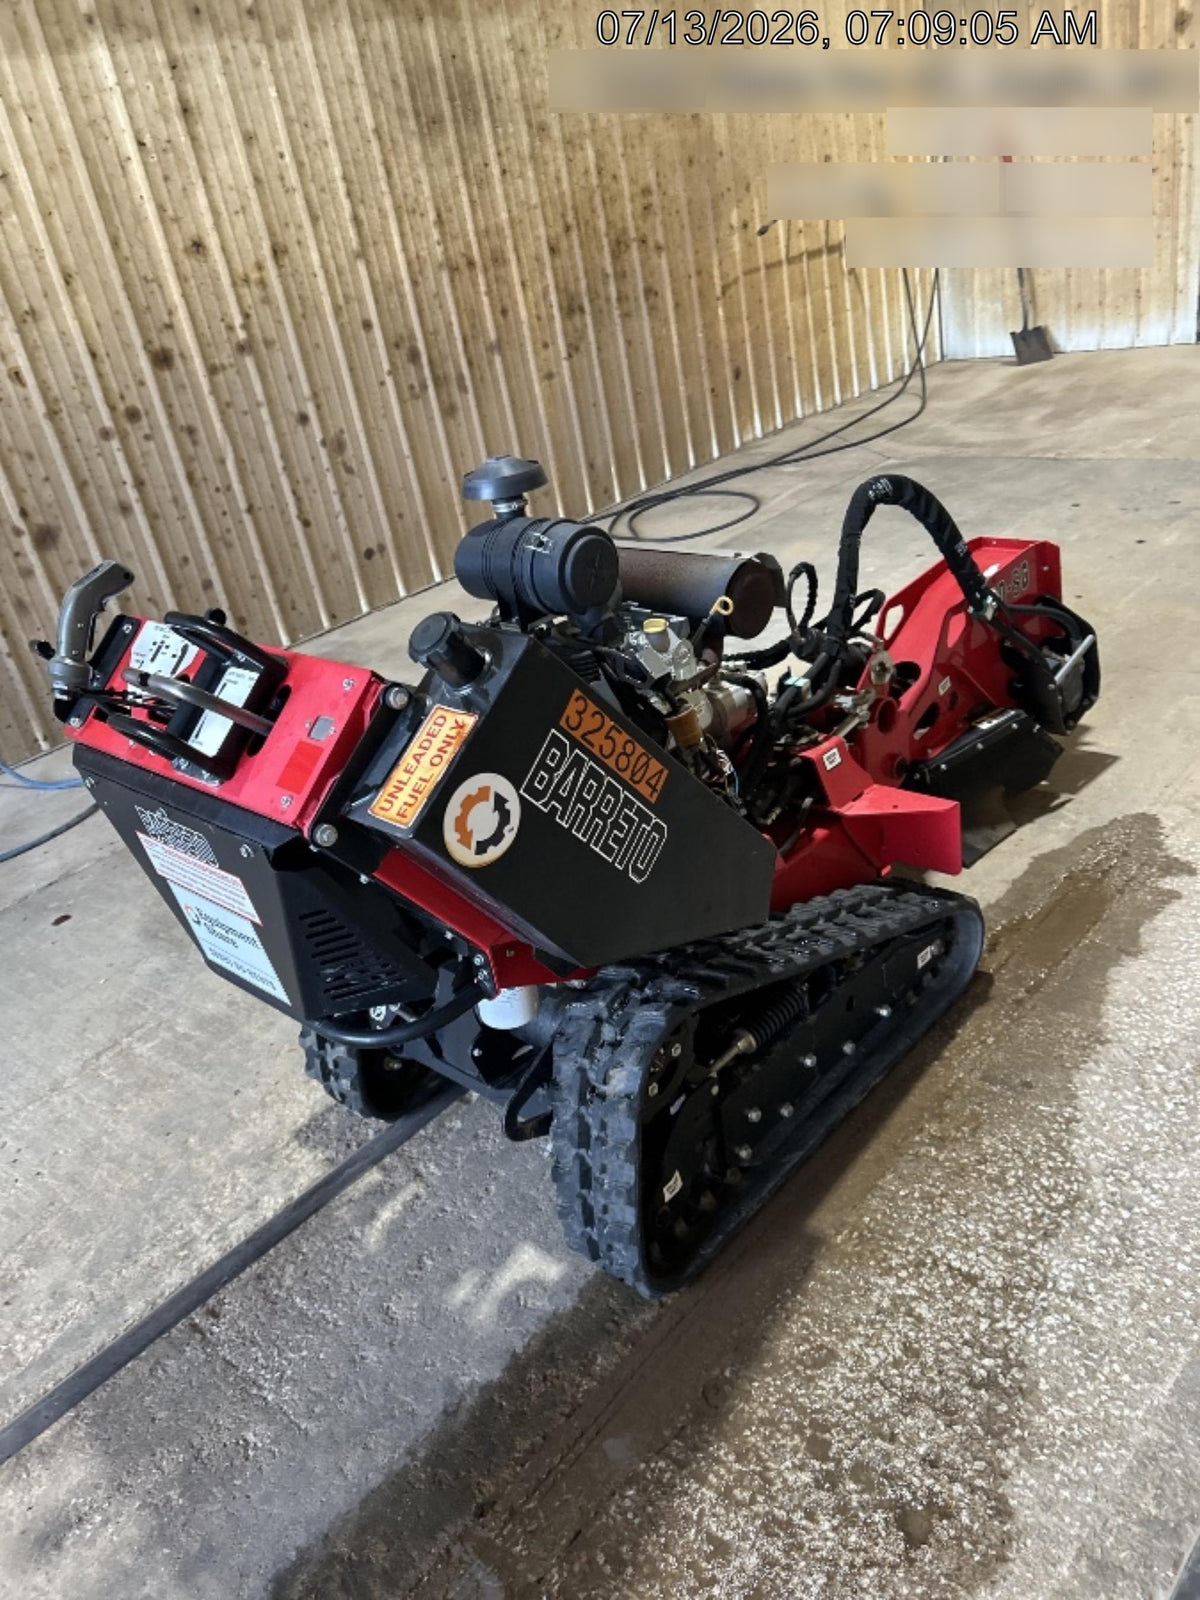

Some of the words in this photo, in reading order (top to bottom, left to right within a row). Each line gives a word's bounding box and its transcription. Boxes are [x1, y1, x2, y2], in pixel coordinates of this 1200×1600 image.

[379, 714, 448, 813] UNLEADED
[396, 772, 434, 819] FUEL
[430, 717, 465, 768] ONLY
[565, 695, 663, 797] 325804
[520, 728, 668, 884] BARRETO
